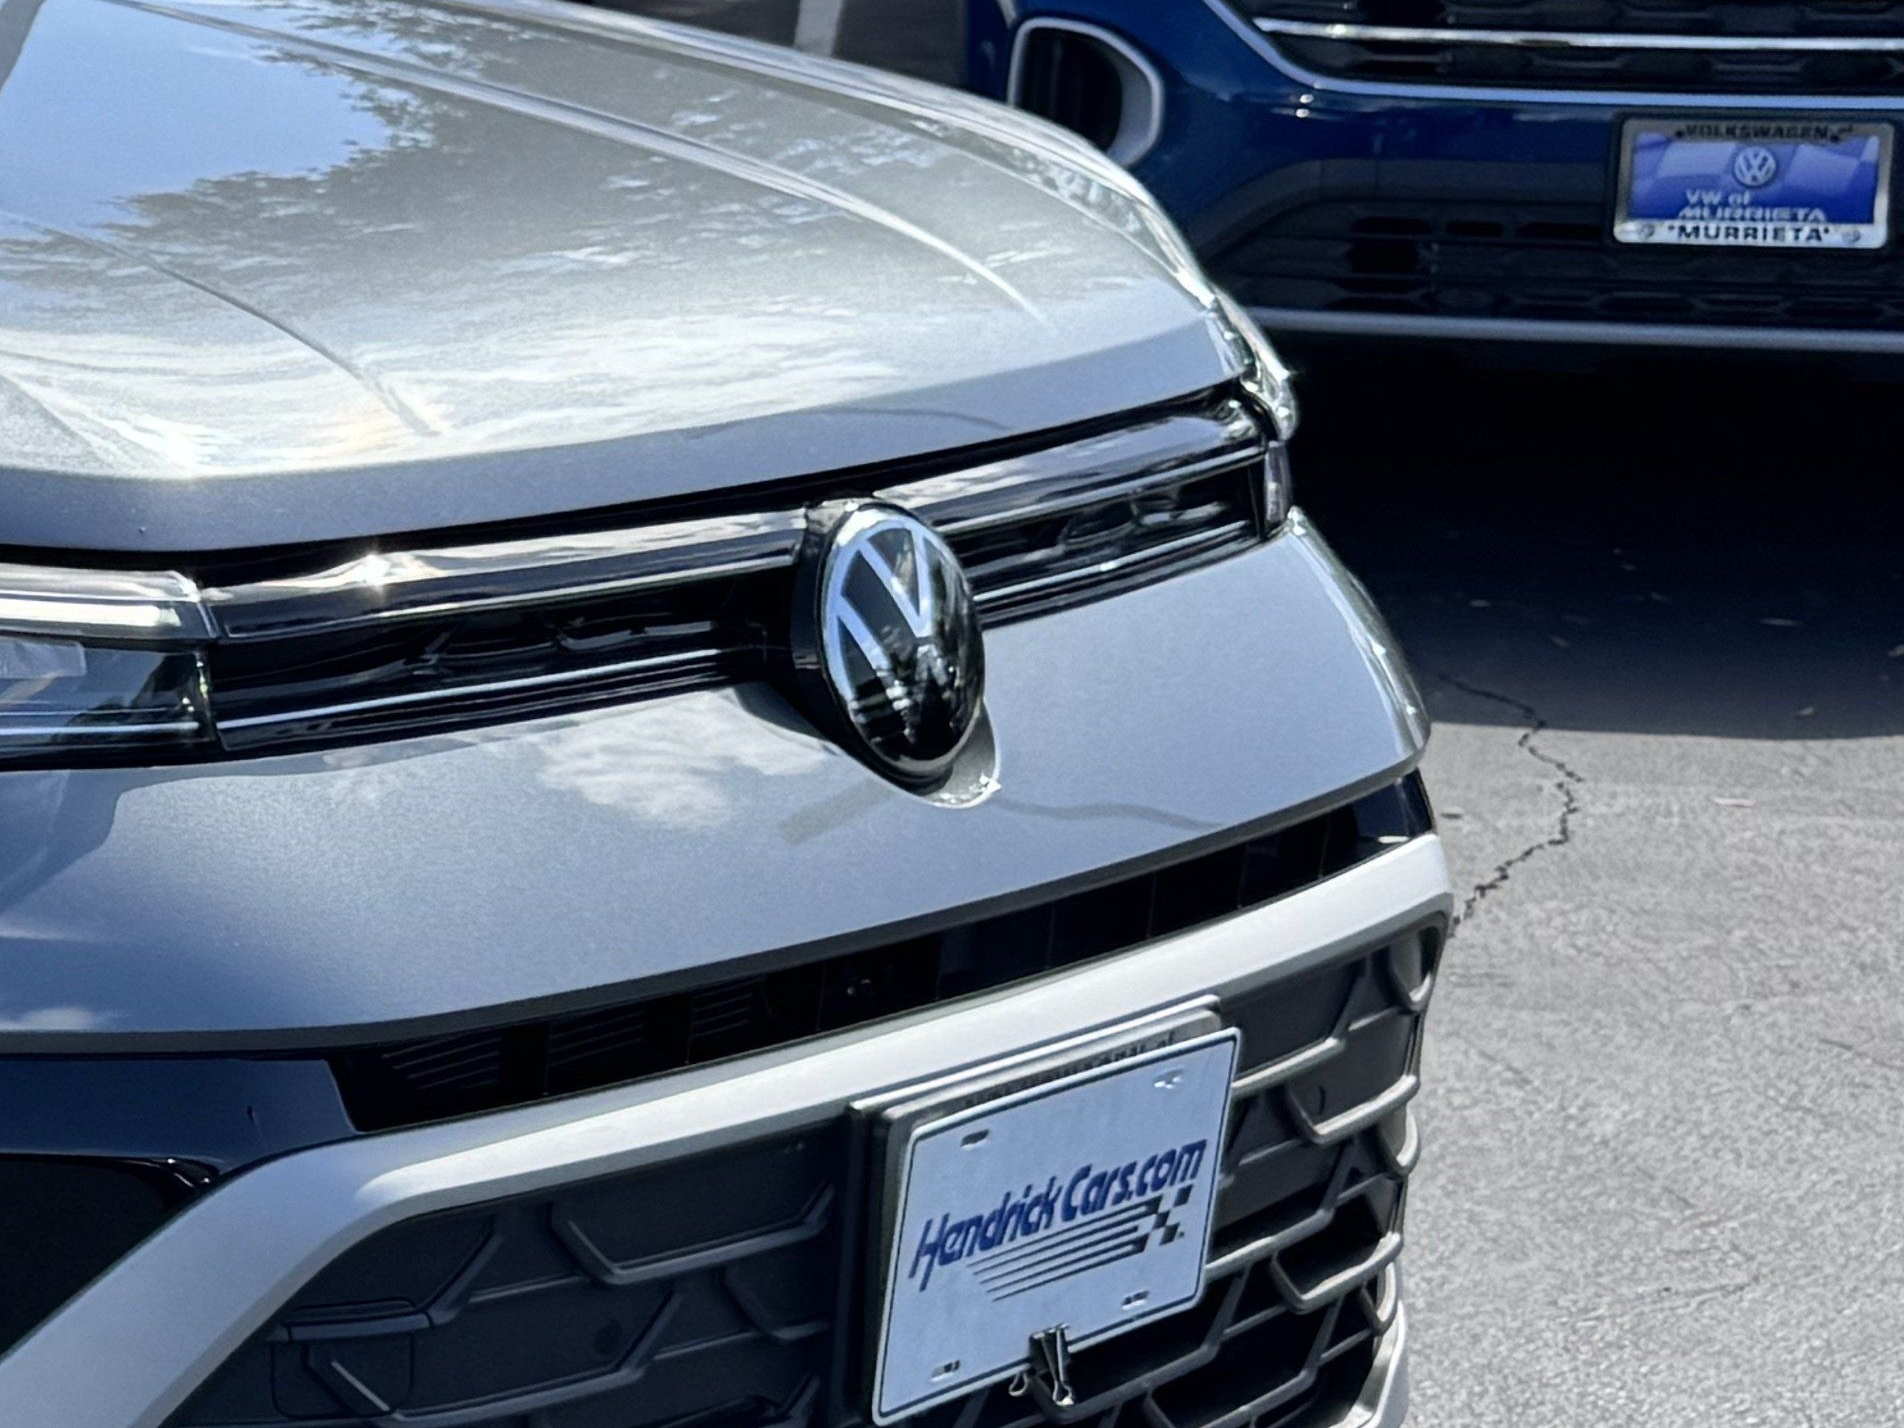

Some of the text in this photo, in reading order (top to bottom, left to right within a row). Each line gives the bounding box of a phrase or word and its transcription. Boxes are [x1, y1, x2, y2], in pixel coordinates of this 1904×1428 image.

[1684, 123, 1829, 142] VOLKSWAGEN
[1685, 189, 1751, 205] VW of
